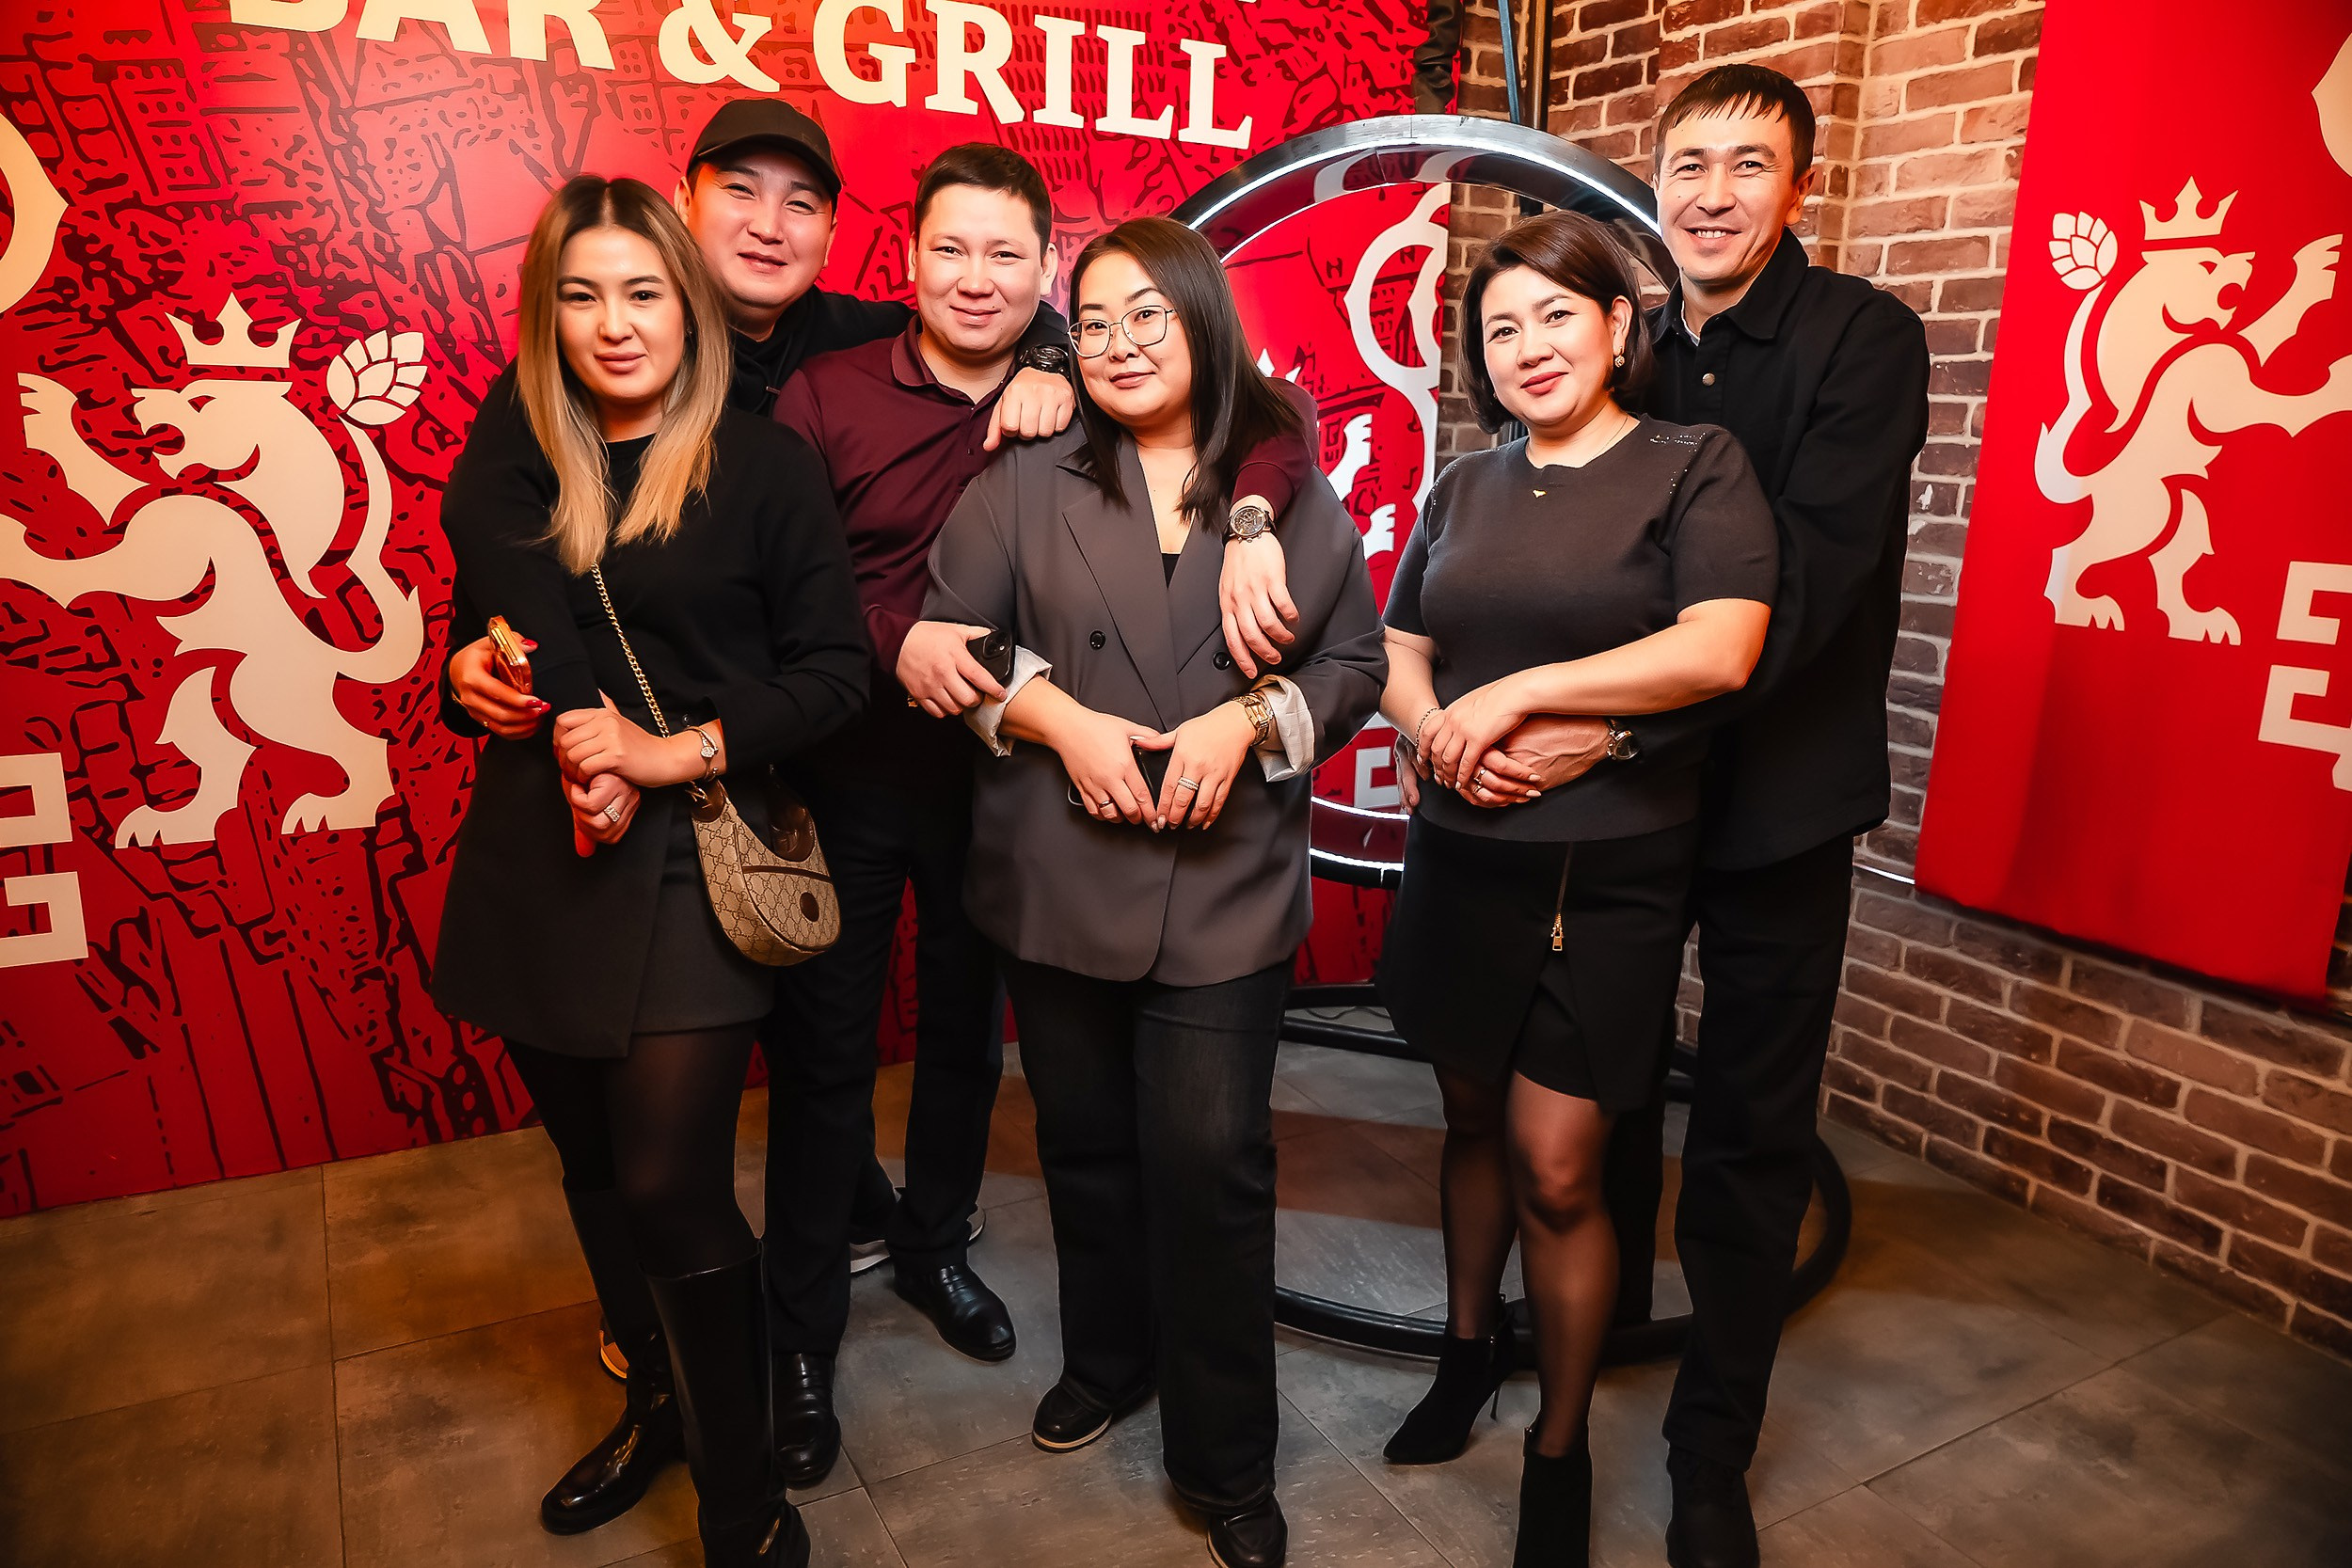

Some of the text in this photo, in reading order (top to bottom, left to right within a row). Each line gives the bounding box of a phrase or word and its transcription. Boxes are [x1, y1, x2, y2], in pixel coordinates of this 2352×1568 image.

[230, 0, 1253, 150] AR & GRILL
